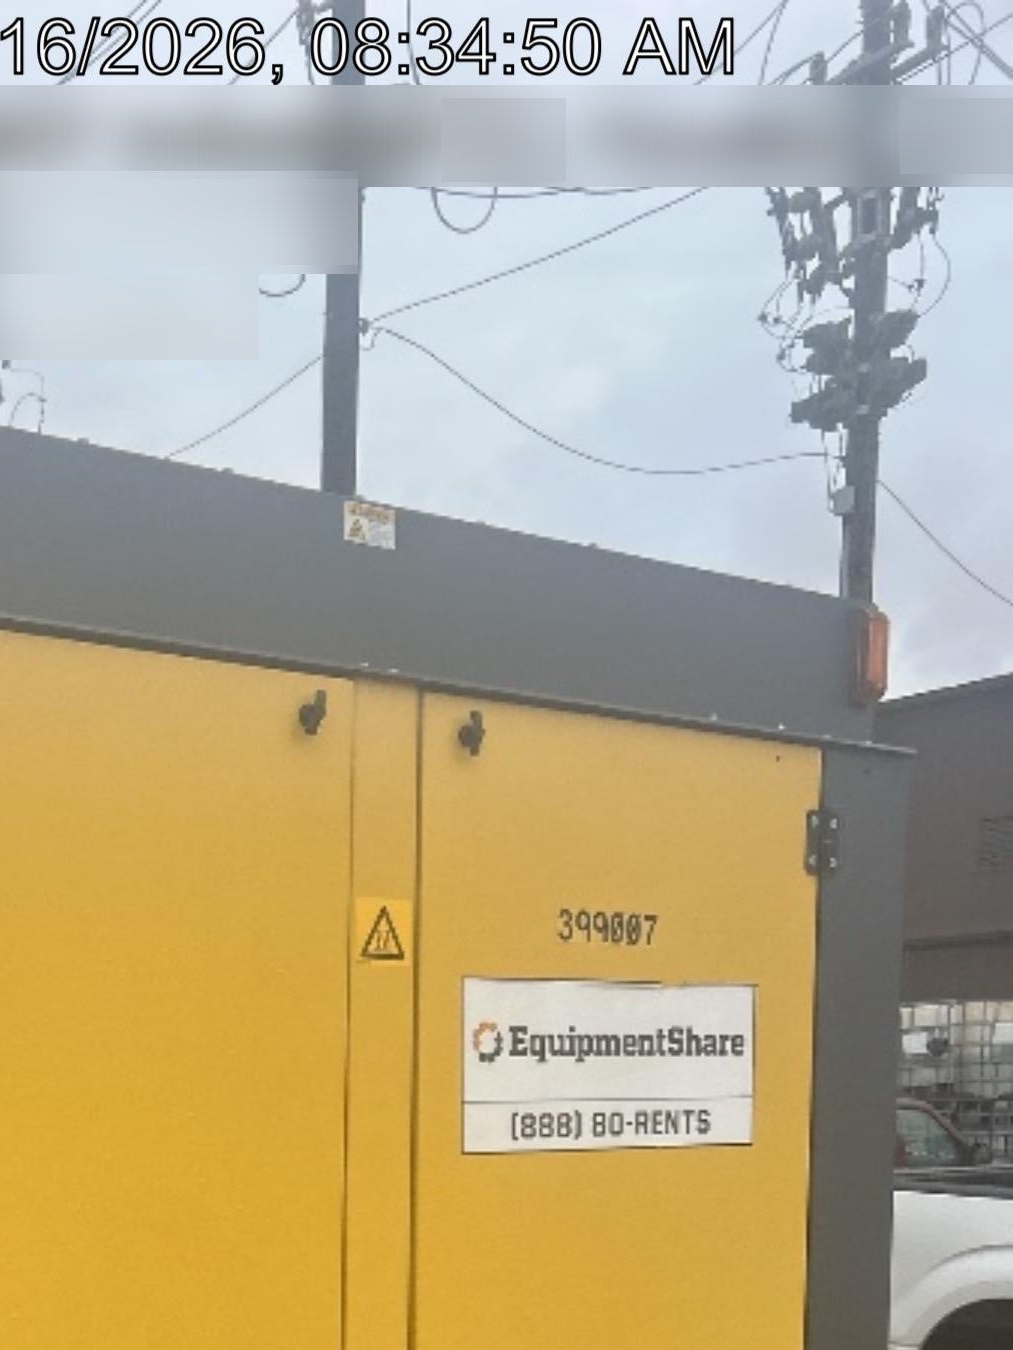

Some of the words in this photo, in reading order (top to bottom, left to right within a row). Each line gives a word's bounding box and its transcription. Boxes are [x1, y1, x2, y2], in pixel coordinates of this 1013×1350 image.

[558, 908, 658, 946] 399007
[508, 1025, 745, 1062] EquipmentShare
[511, 1110, 582, 1140] (888)
[592, 1109, 712, 1137] 80-RENTS
